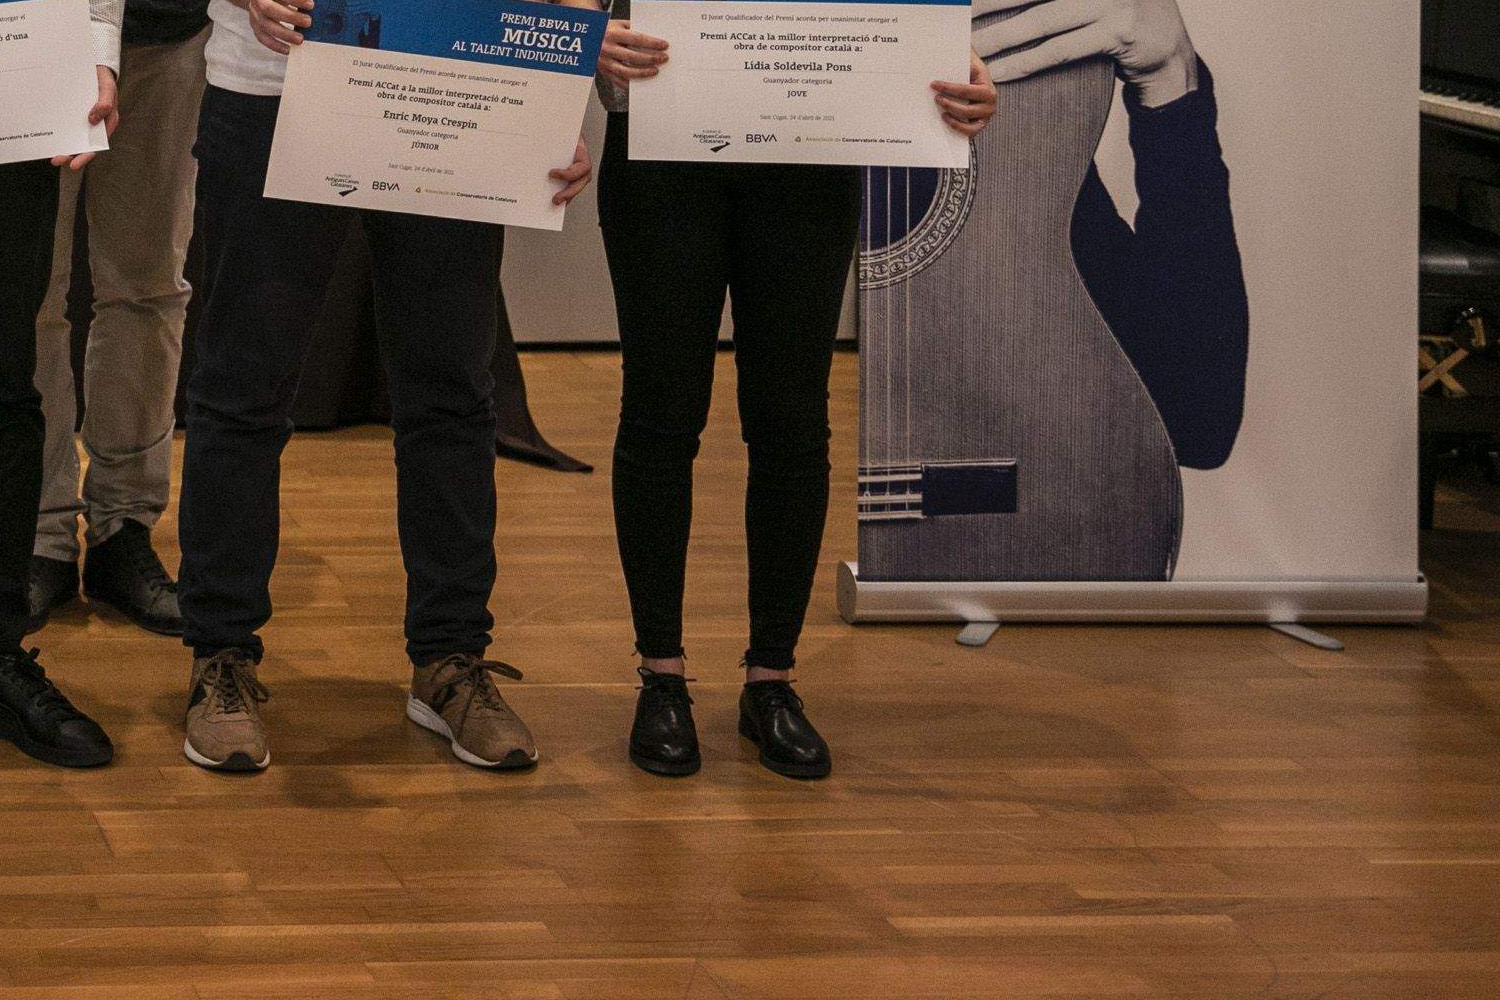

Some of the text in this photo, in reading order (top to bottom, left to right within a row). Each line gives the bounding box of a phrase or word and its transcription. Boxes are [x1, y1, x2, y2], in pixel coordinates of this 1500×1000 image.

[499, 12, 589, 34] PREMI BBVA DE
[501, 26, 582, 53] MÚSICA
[700, 32, 727, 40] Premi
[729, 32, 757, 41] ACCat
[767, 32, 776, 41] la
[777, 33, 806, 41] millor
[808, 34, 870, 43] interpretació
[451, 40, 579, 66] AL TALENT INDIVIDUAL
[733, 42, 754, 50] obra
[756, 42, 768, 50] de
[769, 43, 822, 52] compositor
[773, 61, 823, 71] Soldevila
[826, 62, 852, 72] Pons
[347, 77, 373, 87] Premi
[374, 81, 399, 91] ACCat
[408, 84, 416, 92] la
[418, 86, 444, 96] millor
[445, 89, 499, 103] interpretació
[787, 90, 807, 98] JOVE
[376, 90, 395, 100] obra
[397, 93, 407, 101] de
[408, 96, 456, 107] compositor
[383, 110, 409, 121] Enric
[411, 113, 438, 125] Moya
[745, 133, 778, 143] BBVA
[371, 180, 400, 191] BBVA
